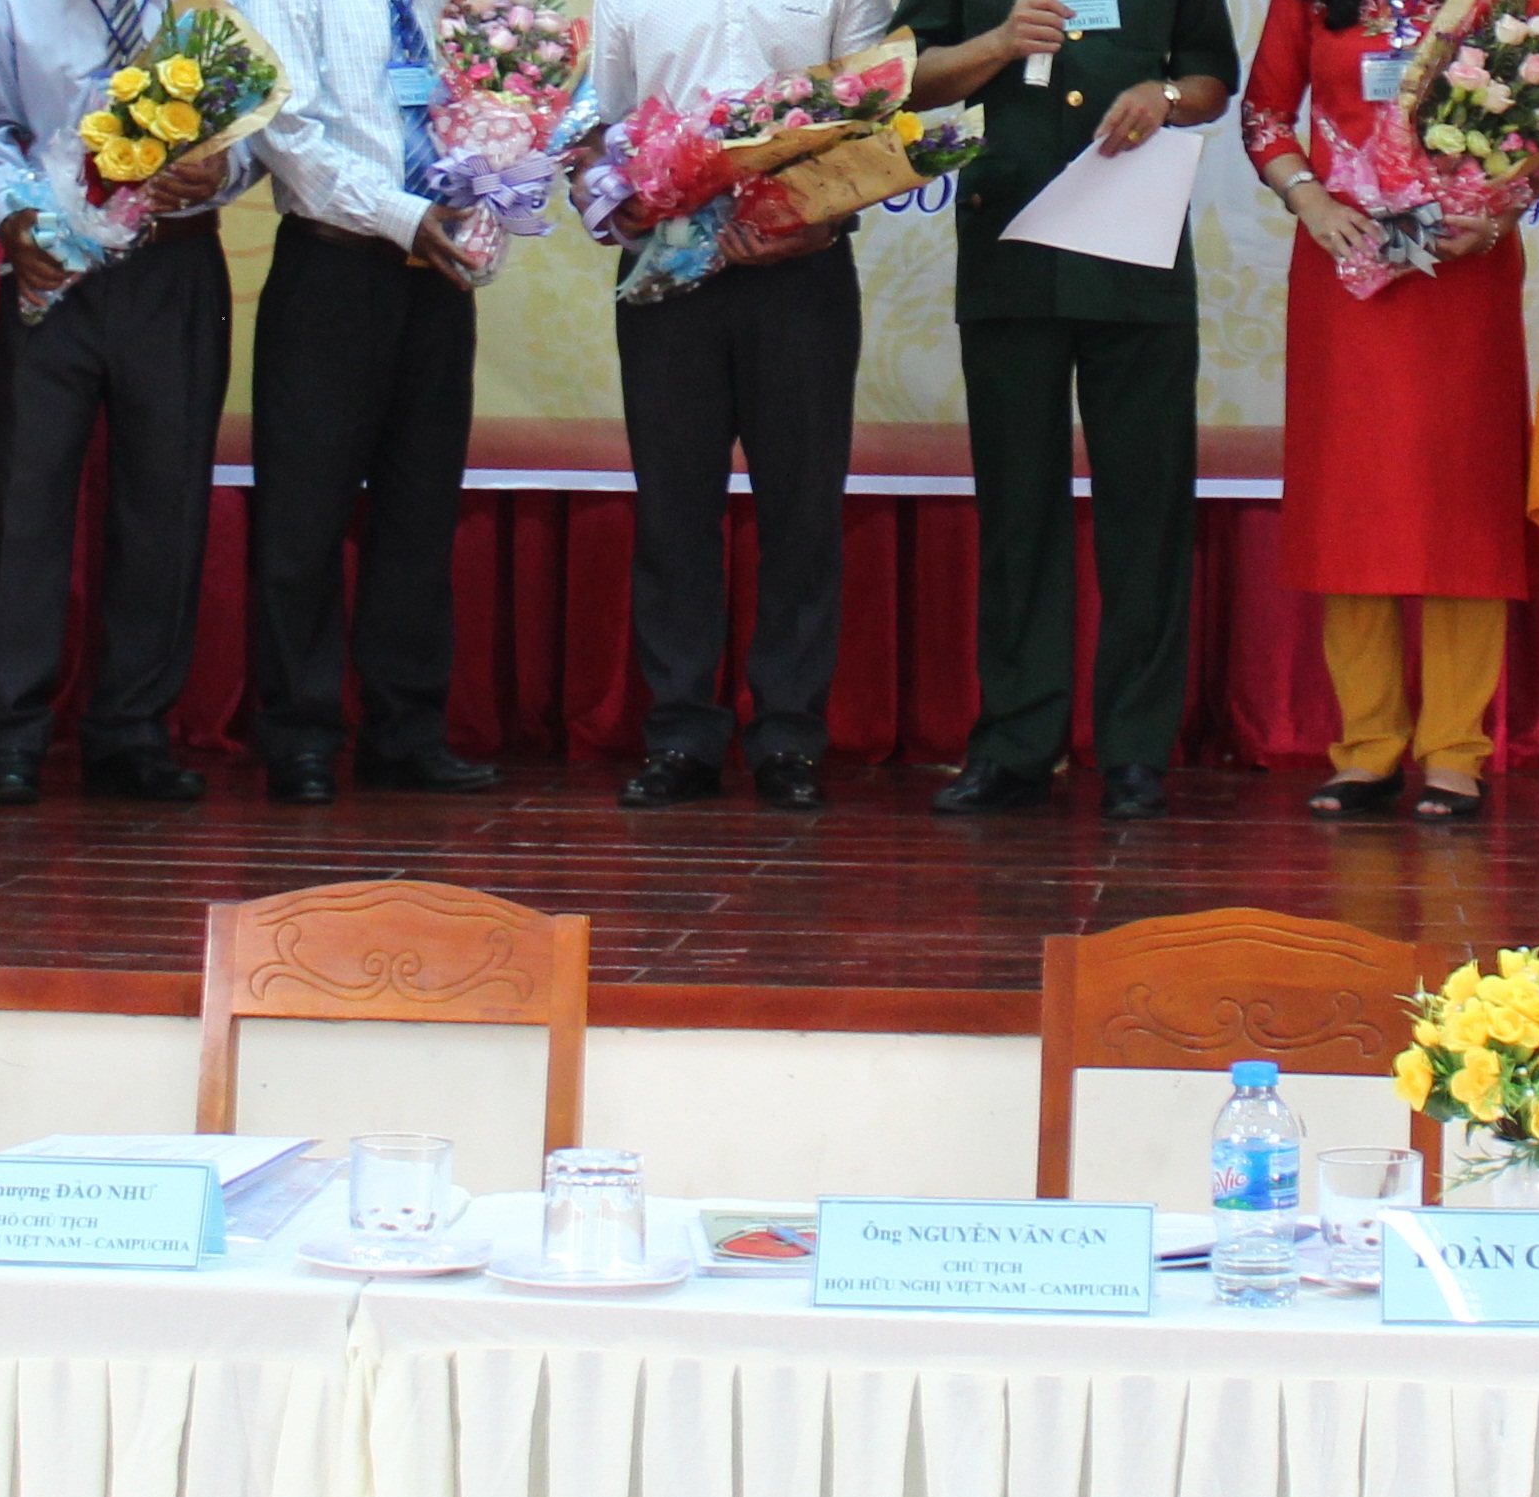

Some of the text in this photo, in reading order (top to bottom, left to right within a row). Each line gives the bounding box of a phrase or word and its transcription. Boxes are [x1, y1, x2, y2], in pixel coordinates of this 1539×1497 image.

[46, 1236, 82, 1249] NAM
[94, 1237, 190, 1253] CAMPUCHIA
[988, 1282, 1026, 1295] NAM
[1039, 1283, 1141, 1298] CAMPUCHIA
